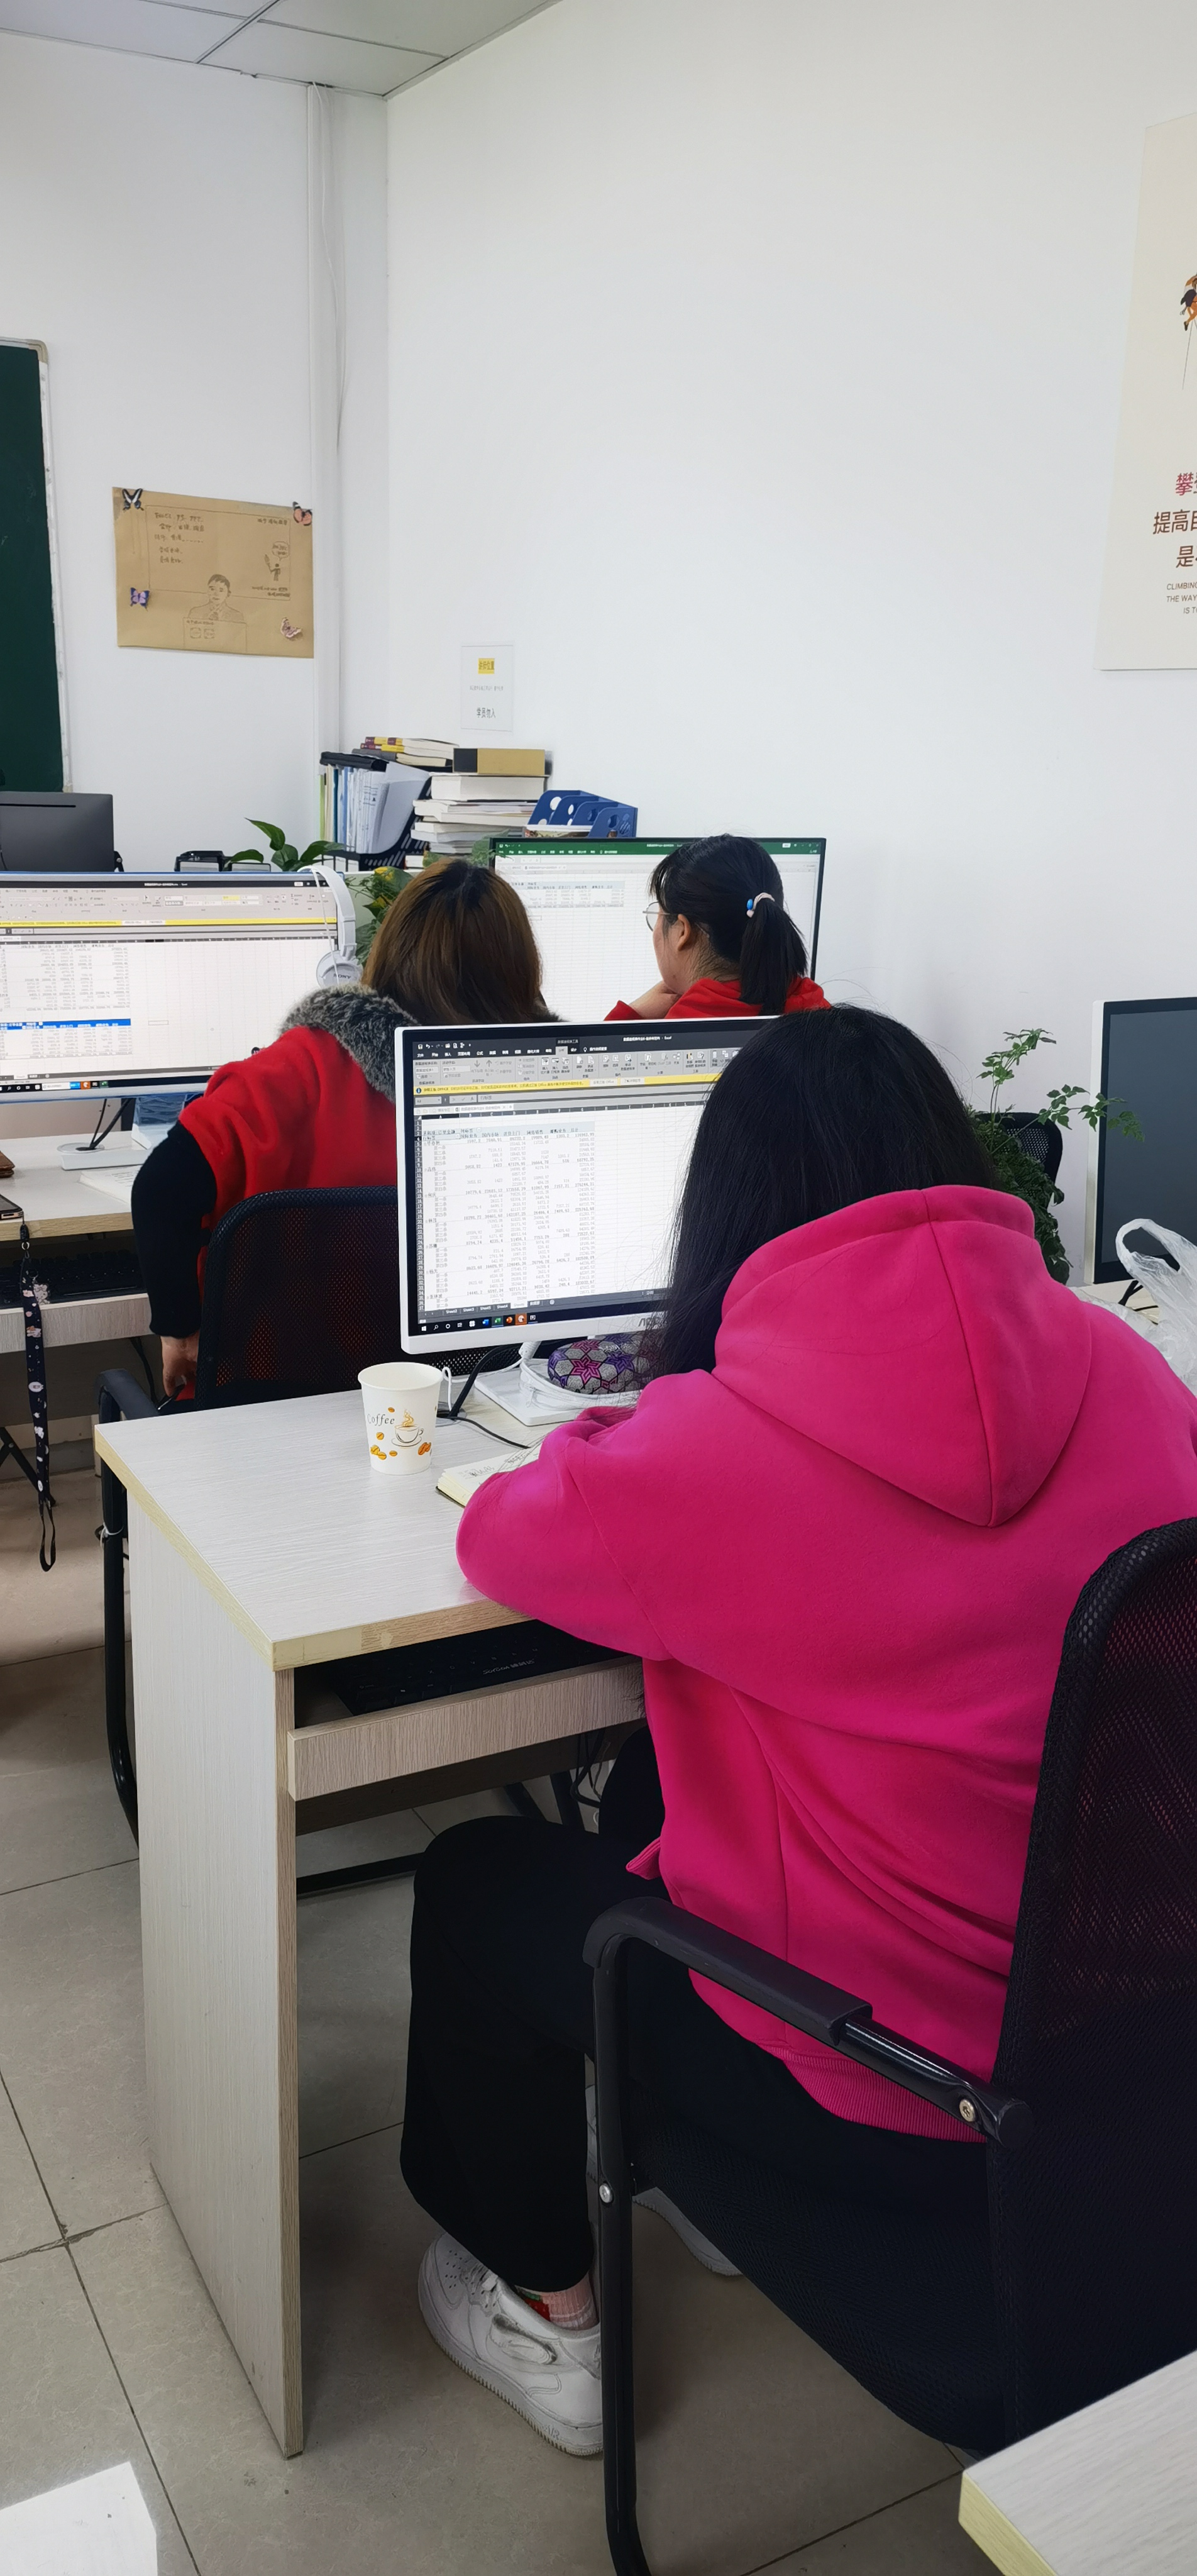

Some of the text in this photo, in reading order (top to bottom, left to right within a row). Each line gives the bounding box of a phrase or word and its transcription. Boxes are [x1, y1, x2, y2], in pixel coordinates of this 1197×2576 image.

[1153, 509, 1197, 535] 提高
[1176, 545, 1197, 568] 是
[1181, 594, 1197, 602] WAY
[367, 1413, 395, 1426] Coffee
